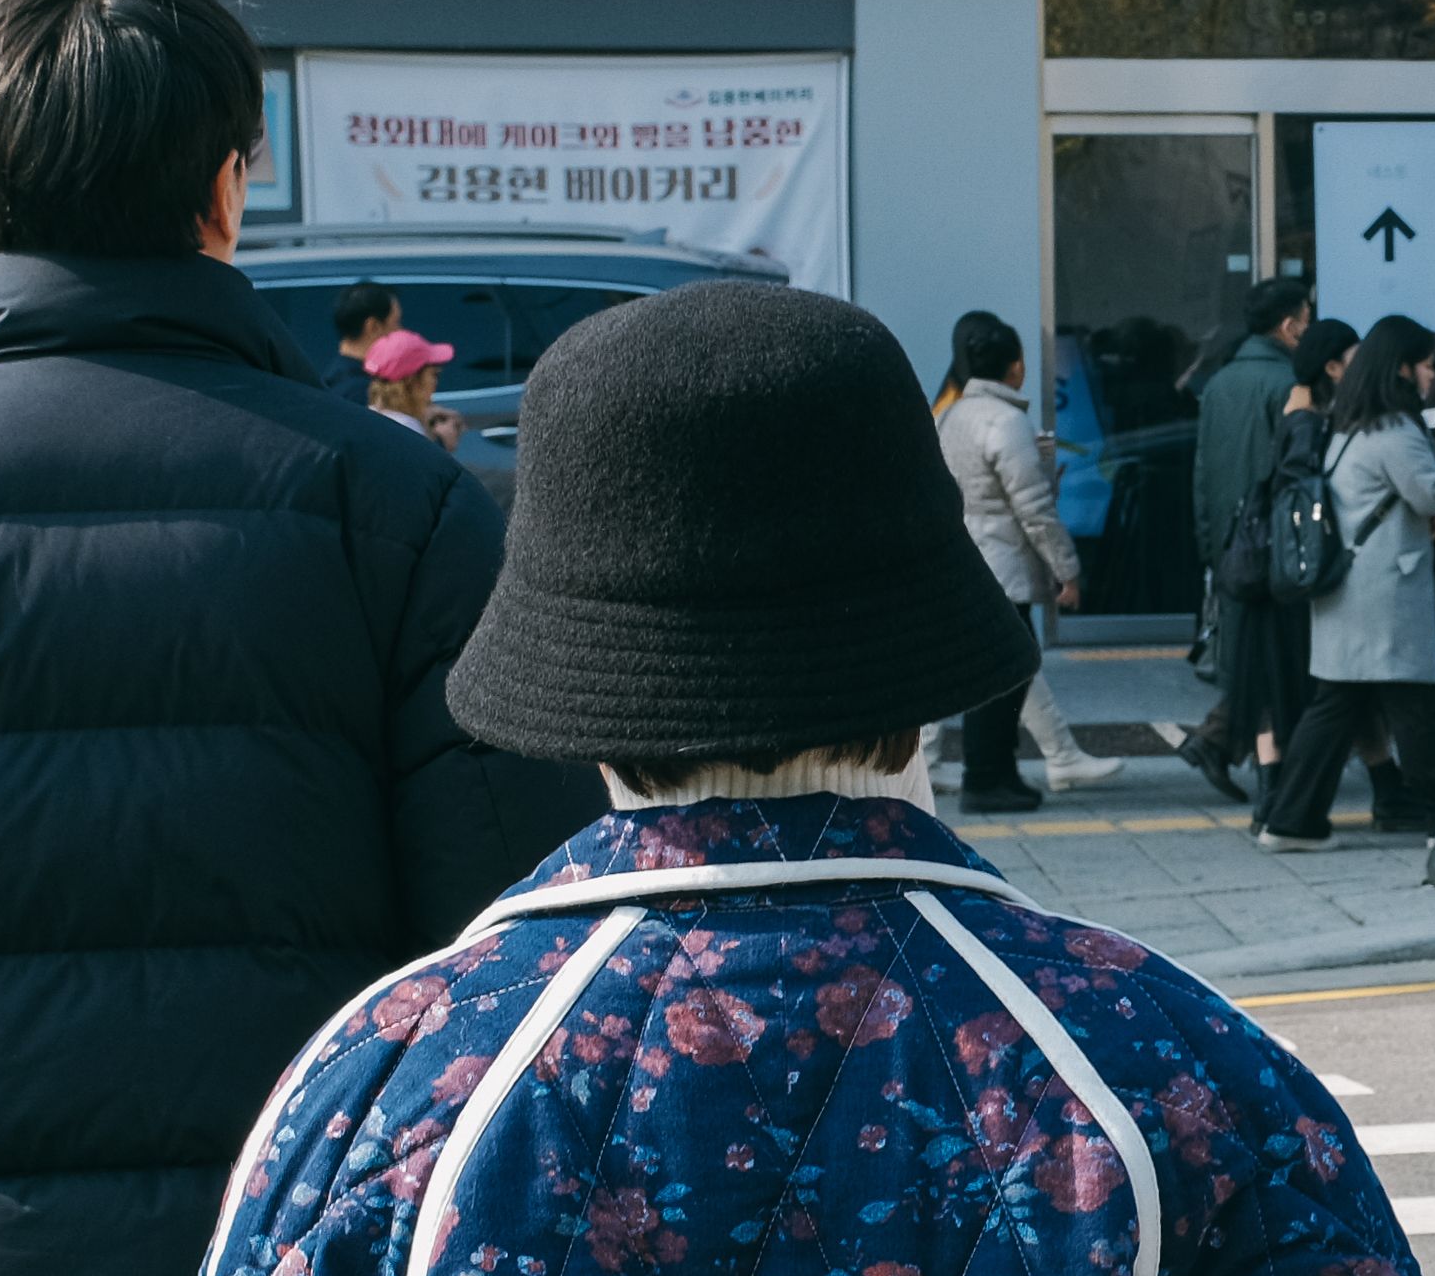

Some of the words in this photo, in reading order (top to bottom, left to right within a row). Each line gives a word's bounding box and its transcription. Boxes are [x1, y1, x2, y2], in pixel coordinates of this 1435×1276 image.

[347, 112, 488, 149] 청와대에
[500, 123, 621, 149] 케이크와
[417, 164, 549, 204] 김용현
[565, 164, 738, 204] 베이커리
